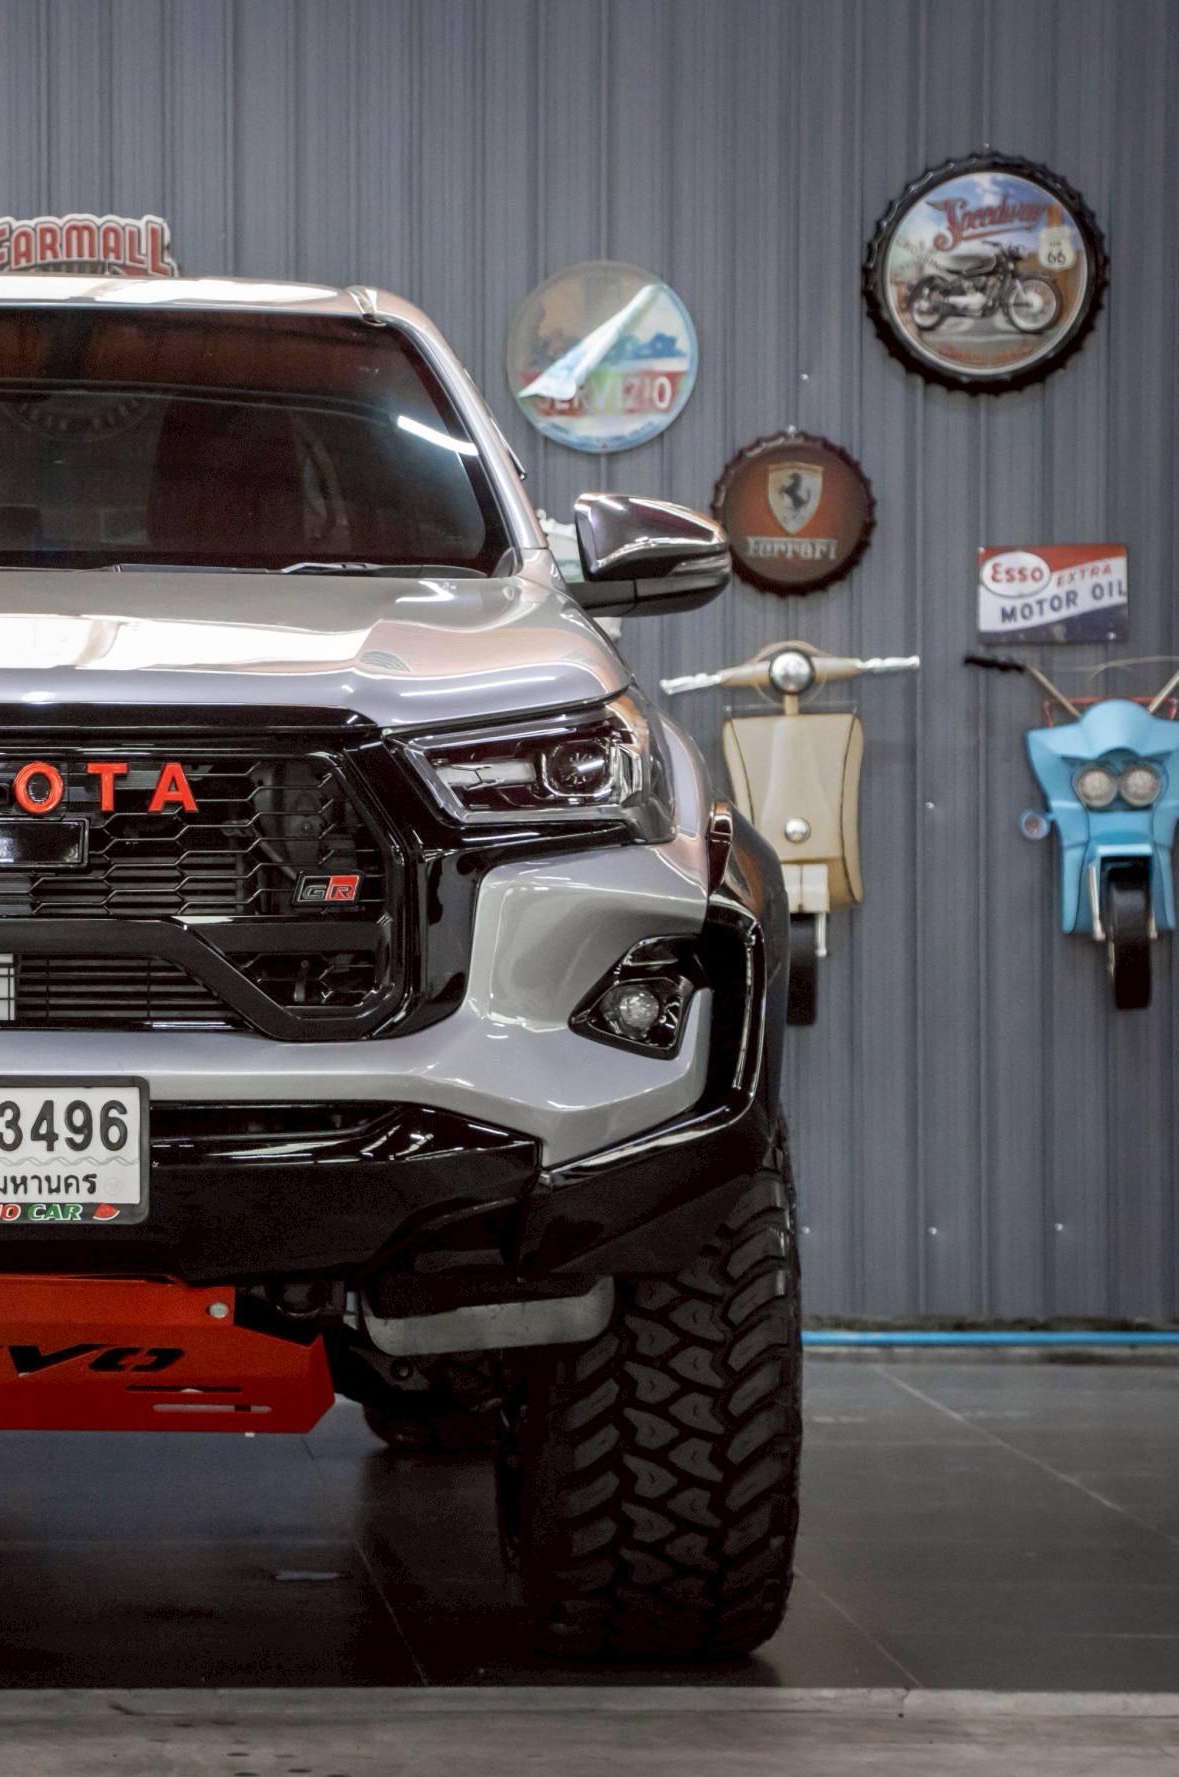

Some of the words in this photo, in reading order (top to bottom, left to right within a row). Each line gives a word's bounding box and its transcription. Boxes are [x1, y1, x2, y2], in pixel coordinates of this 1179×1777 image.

[1056, 562, 1113, 588] EXTRA
[1000, 590, 1079, 625] MOTOR
[1090, 579, 1128, 602] OIL
[301, 881, 355, 901] GR
[27, 1203, 84, 1221] CAR
